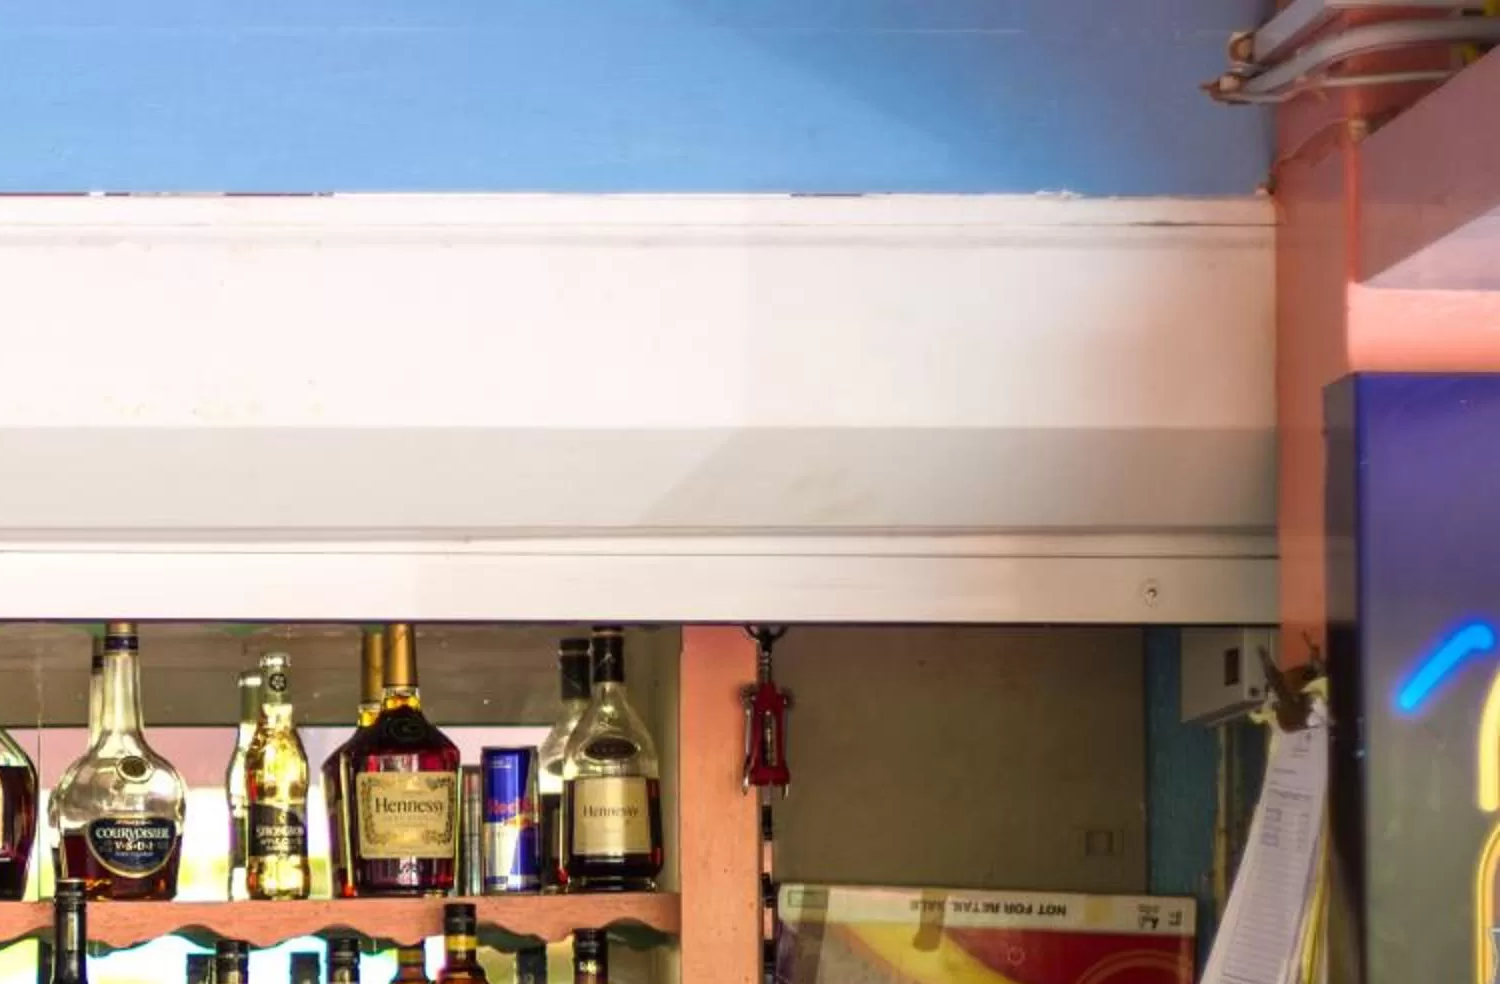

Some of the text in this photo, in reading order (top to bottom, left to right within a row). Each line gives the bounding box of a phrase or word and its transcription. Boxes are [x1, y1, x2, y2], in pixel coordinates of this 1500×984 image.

[375, 797, 443, 814] Hennessy
[1004, 901, 1033, 914] FOR
[1039, 903, 1067, 916] NOT
